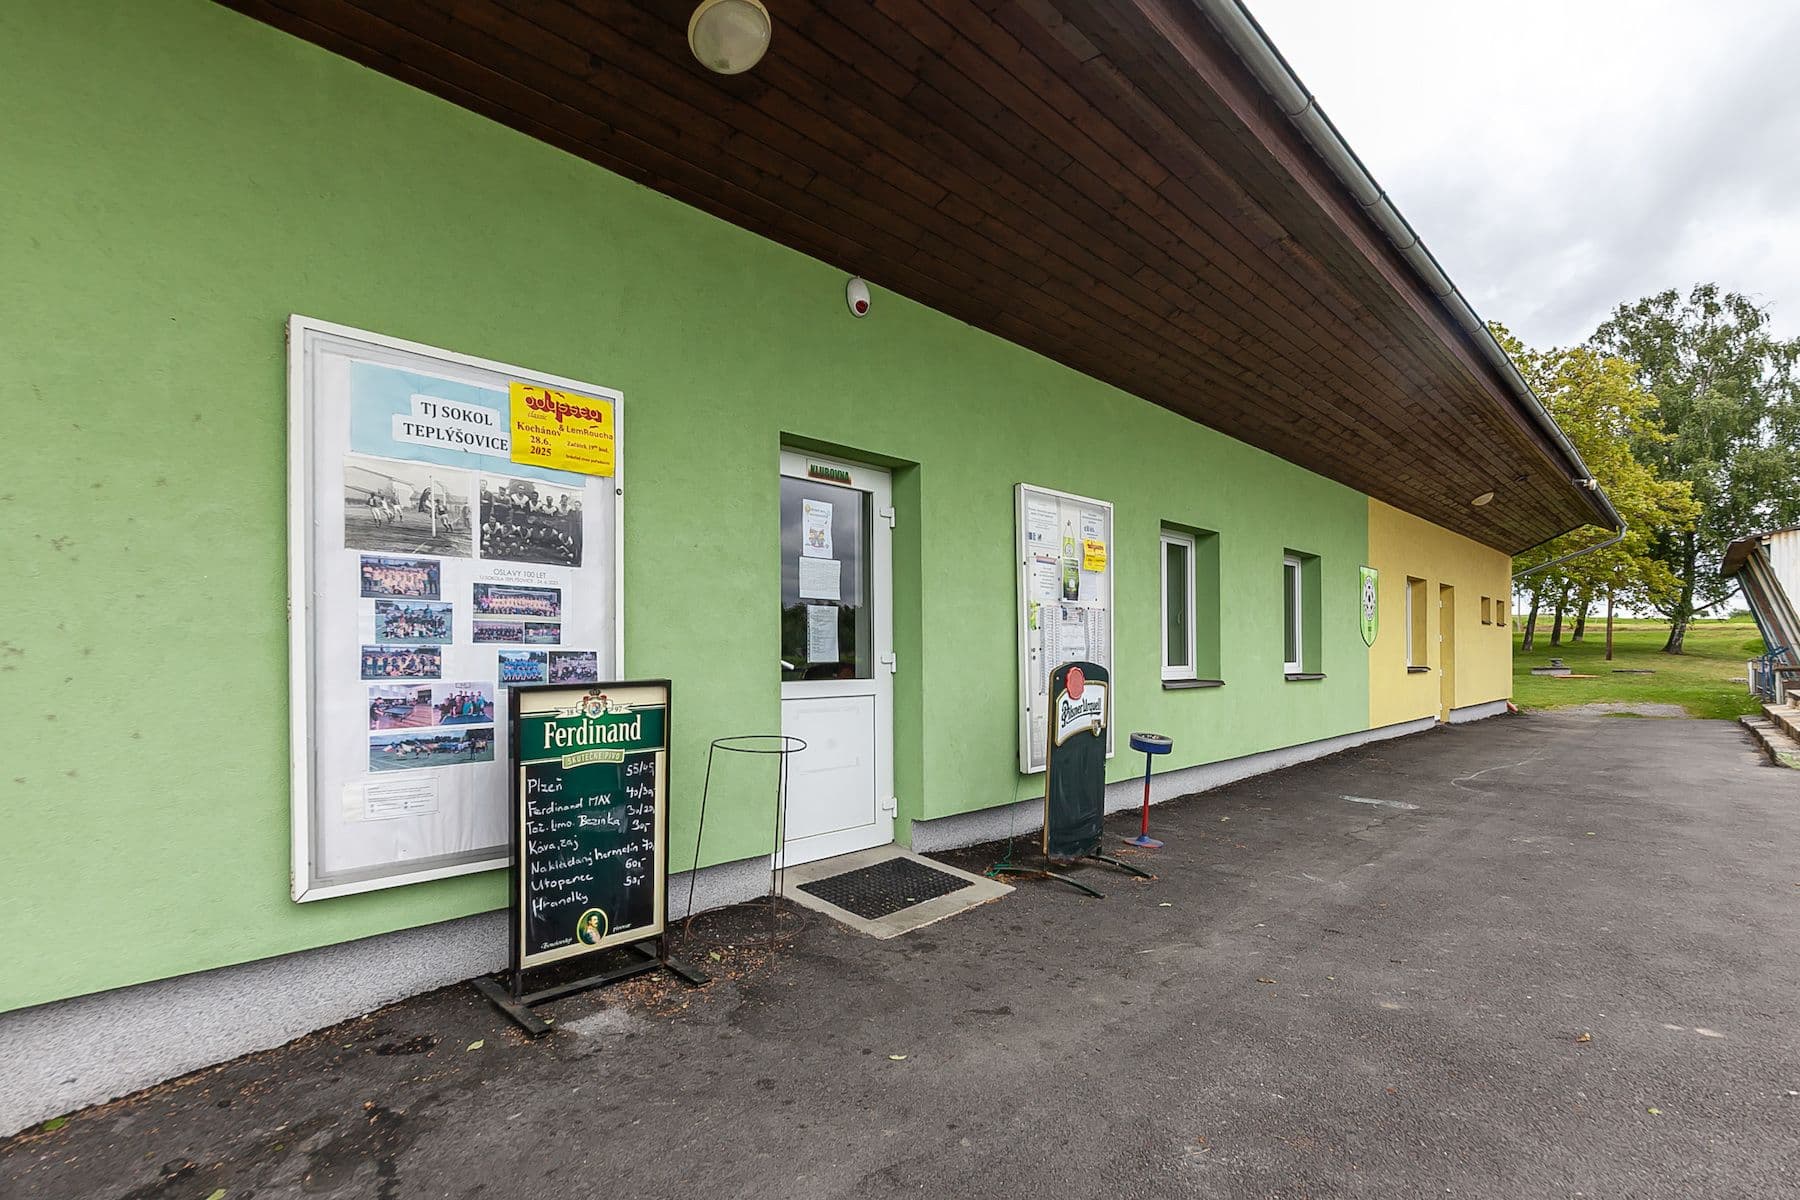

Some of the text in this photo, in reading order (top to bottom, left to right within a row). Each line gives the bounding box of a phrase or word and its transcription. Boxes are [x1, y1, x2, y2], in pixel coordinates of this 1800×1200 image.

[420, 401, 493, 426] TJ SOKOL
[403, 422, 509, 451] TEPLÝŠOVICE
[517, 421, 561, 436] Kochánov
[559, 424, 614, 440] & LemRoucha
[530, 435, 552, 446] 28.6.
[530, 446, 552, 457] 2025
[810, 464, 849, 480] KLUBOVNA
[493, 568, 521, 577] OSLAVY
[523, 570, 536, 578] 100
[1061, 697, 1101, 728] Pilsner Urquell
[543, 714, 642, 749] Ferdinand
[527, 777, 563, 794] Plzeň
[528, 798, 584, 817] Ferdinand
[588, 793, 612, 807] MAX
[577, 812, 621, 827] Bezinka
[531, 873, 594, 892] Utopenec
[532, 891, 589, 917] Hranolky
